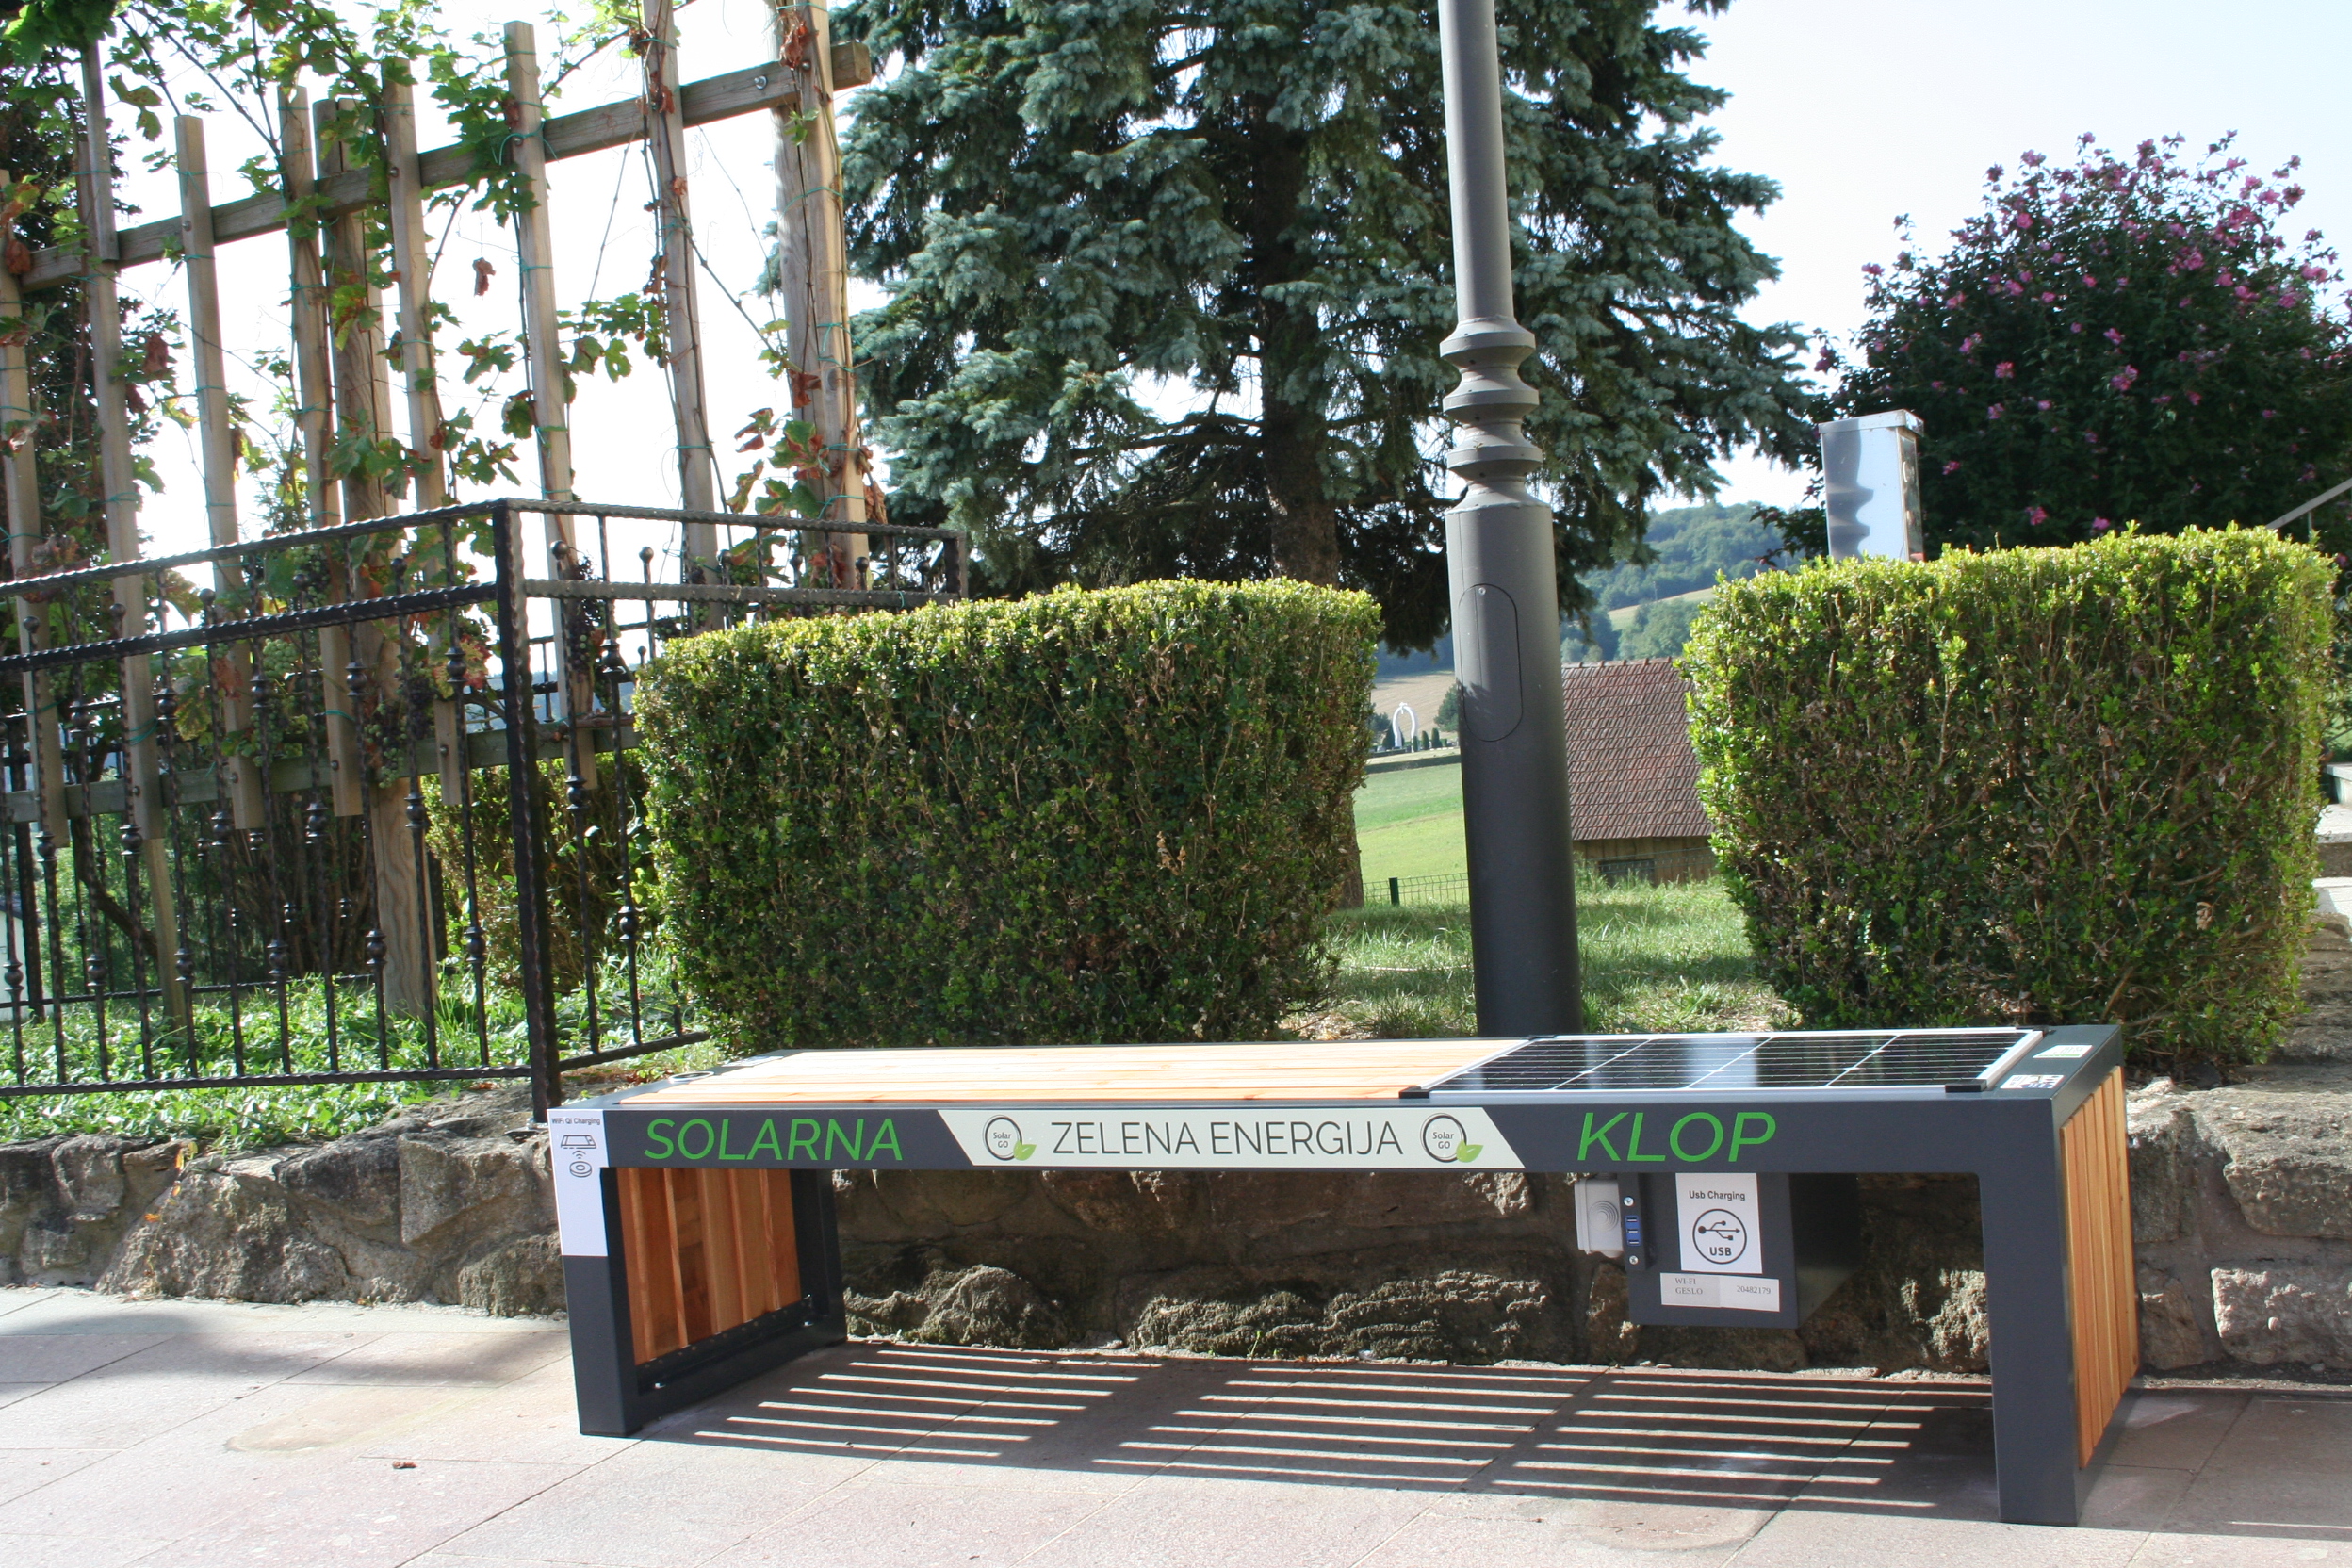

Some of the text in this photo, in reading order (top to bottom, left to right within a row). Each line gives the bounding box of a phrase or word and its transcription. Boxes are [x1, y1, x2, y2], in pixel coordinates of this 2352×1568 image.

[574, 1117, 601, 1126] Charging
[644, 1118, 904, 1161] SOLARNA
[992, 1131, 1012, 1139] Solar
[1051, 1120, 1404, 1155] ZELENA ENERGIJA
[1432, 1131, 1454, 1139] Solar
[1576, 1111, 1777, 1163] KLOP
[997, 1140, 1009, 1149] GO
[1689, 1190, 1746, 1201] Usb Charging
[1709, 1246, 1732, 1256] USB
[1675, 1277, 1697, 1285] WI-FI
[1674, 1286, 1704, 1296] GESLO
[1736, 1284, 1772, 1295] 20482179
